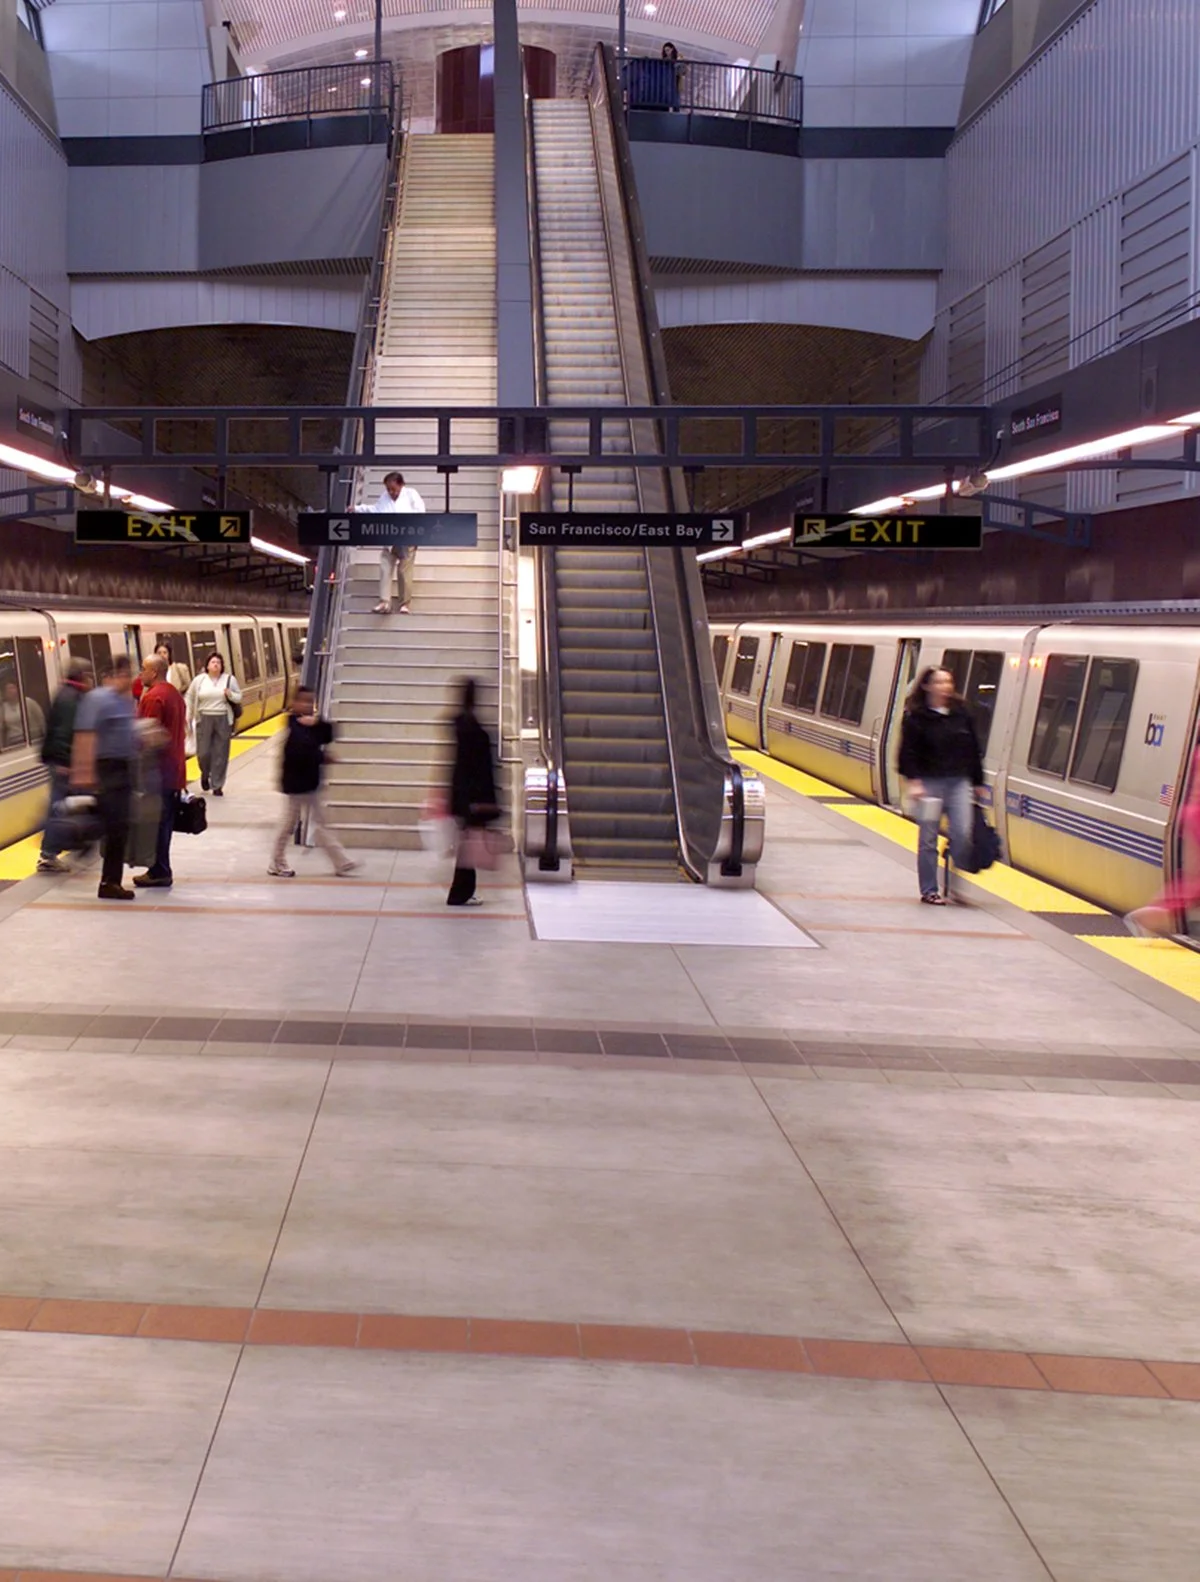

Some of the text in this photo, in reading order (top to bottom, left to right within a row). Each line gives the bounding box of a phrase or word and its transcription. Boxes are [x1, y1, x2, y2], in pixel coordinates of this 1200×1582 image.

[127, 515, 197, 538] EXIT
[361, 523, 425, 536] Millbrae
[529, 522, 704, 539] San Francisco/East Bay
[850, 519, 926, 543] EXIT
